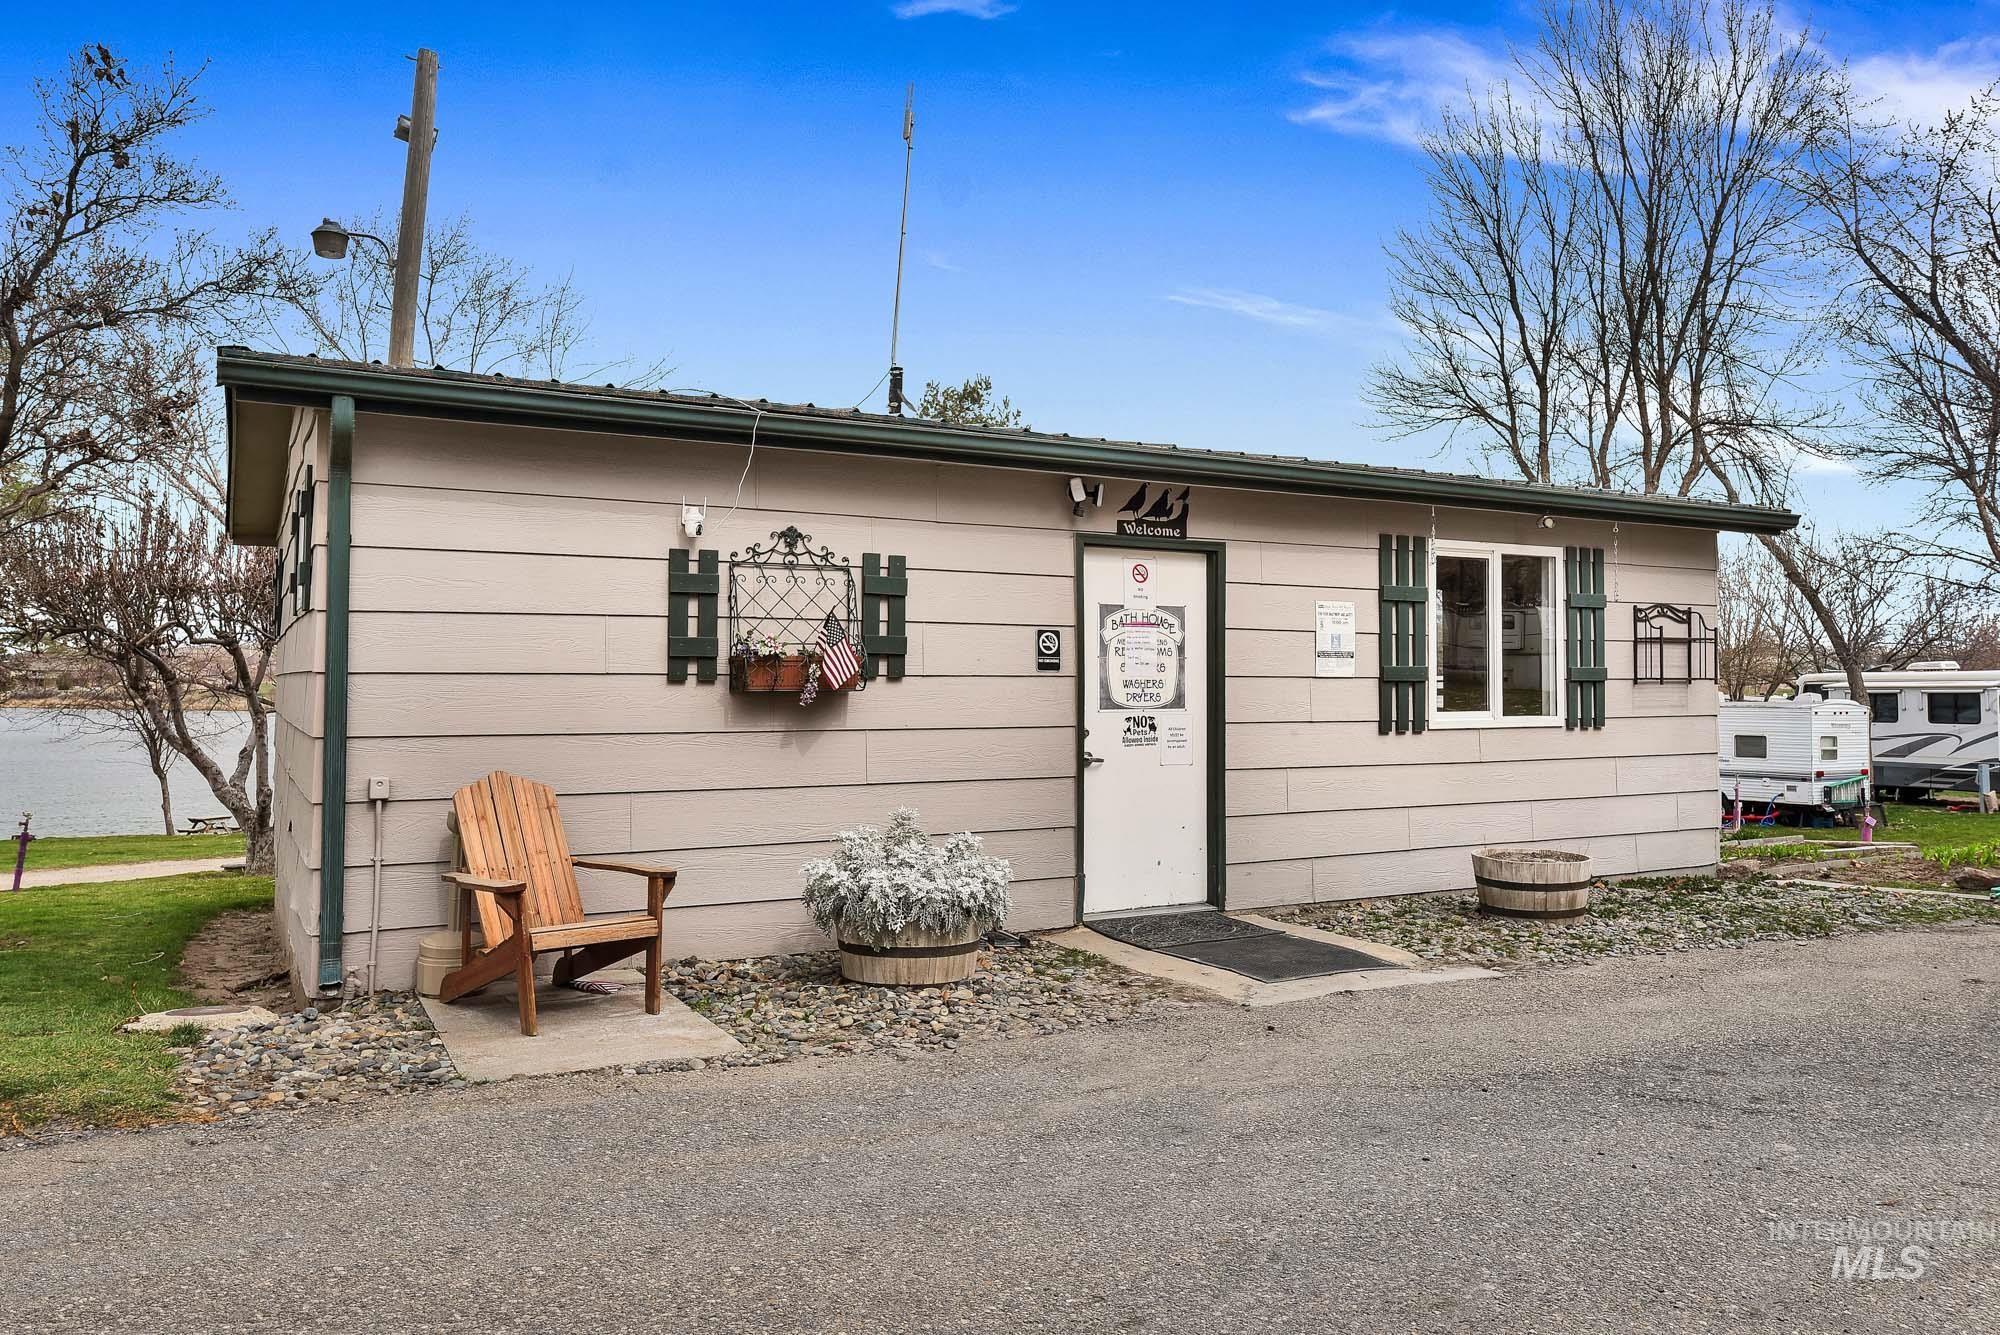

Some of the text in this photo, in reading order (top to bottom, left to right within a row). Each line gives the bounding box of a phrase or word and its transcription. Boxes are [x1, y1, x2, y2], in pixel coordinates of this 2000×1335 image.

[1123, 522, 1181, 537] Welcome
[1111, 612, 1176, 634] BATH HOUSE
[1122, 679, 1164, 689] WASHERS
[1126, 692, 1161, 703] DRYERS
[1132, 715, 1148, 728] NO
[1122, 736, 1143, 744] Allowed
